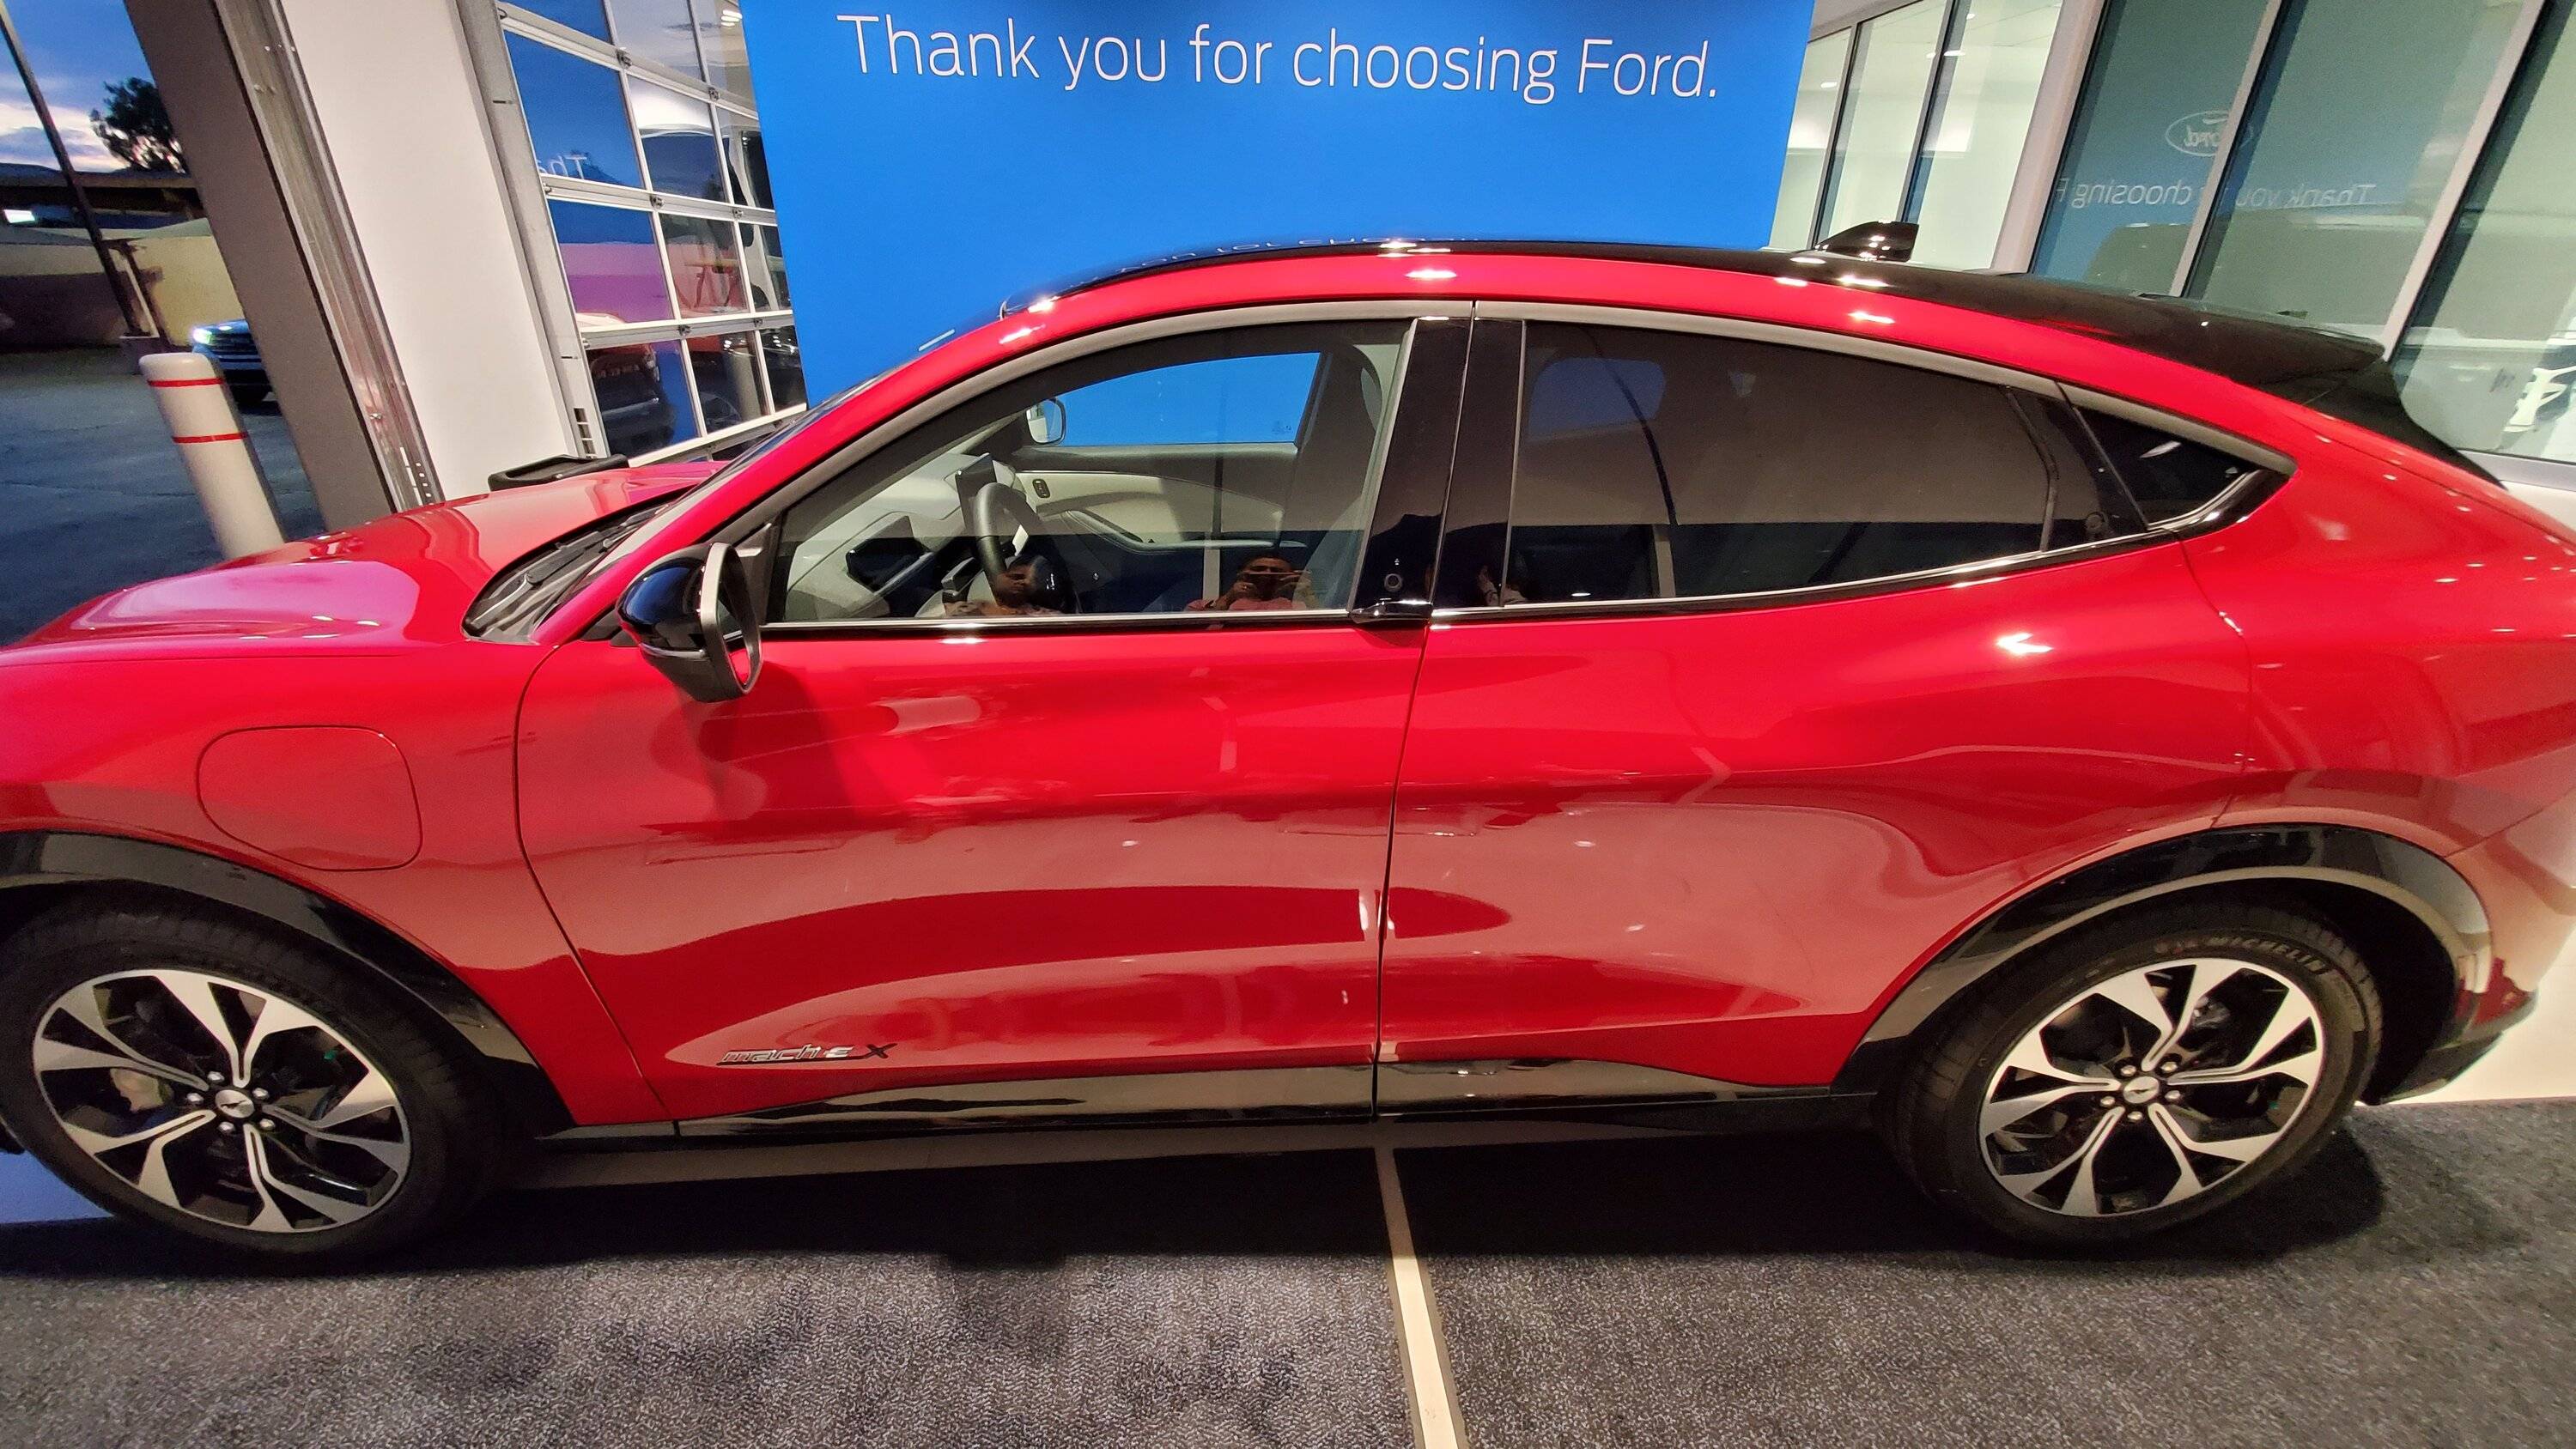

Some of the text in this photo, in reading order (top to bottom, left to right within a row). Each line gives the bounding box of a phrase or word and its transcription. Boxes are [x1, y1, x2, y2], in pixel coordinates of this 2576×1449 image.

[836, 14, 1716, 104] Thank you for choosing Ford.
